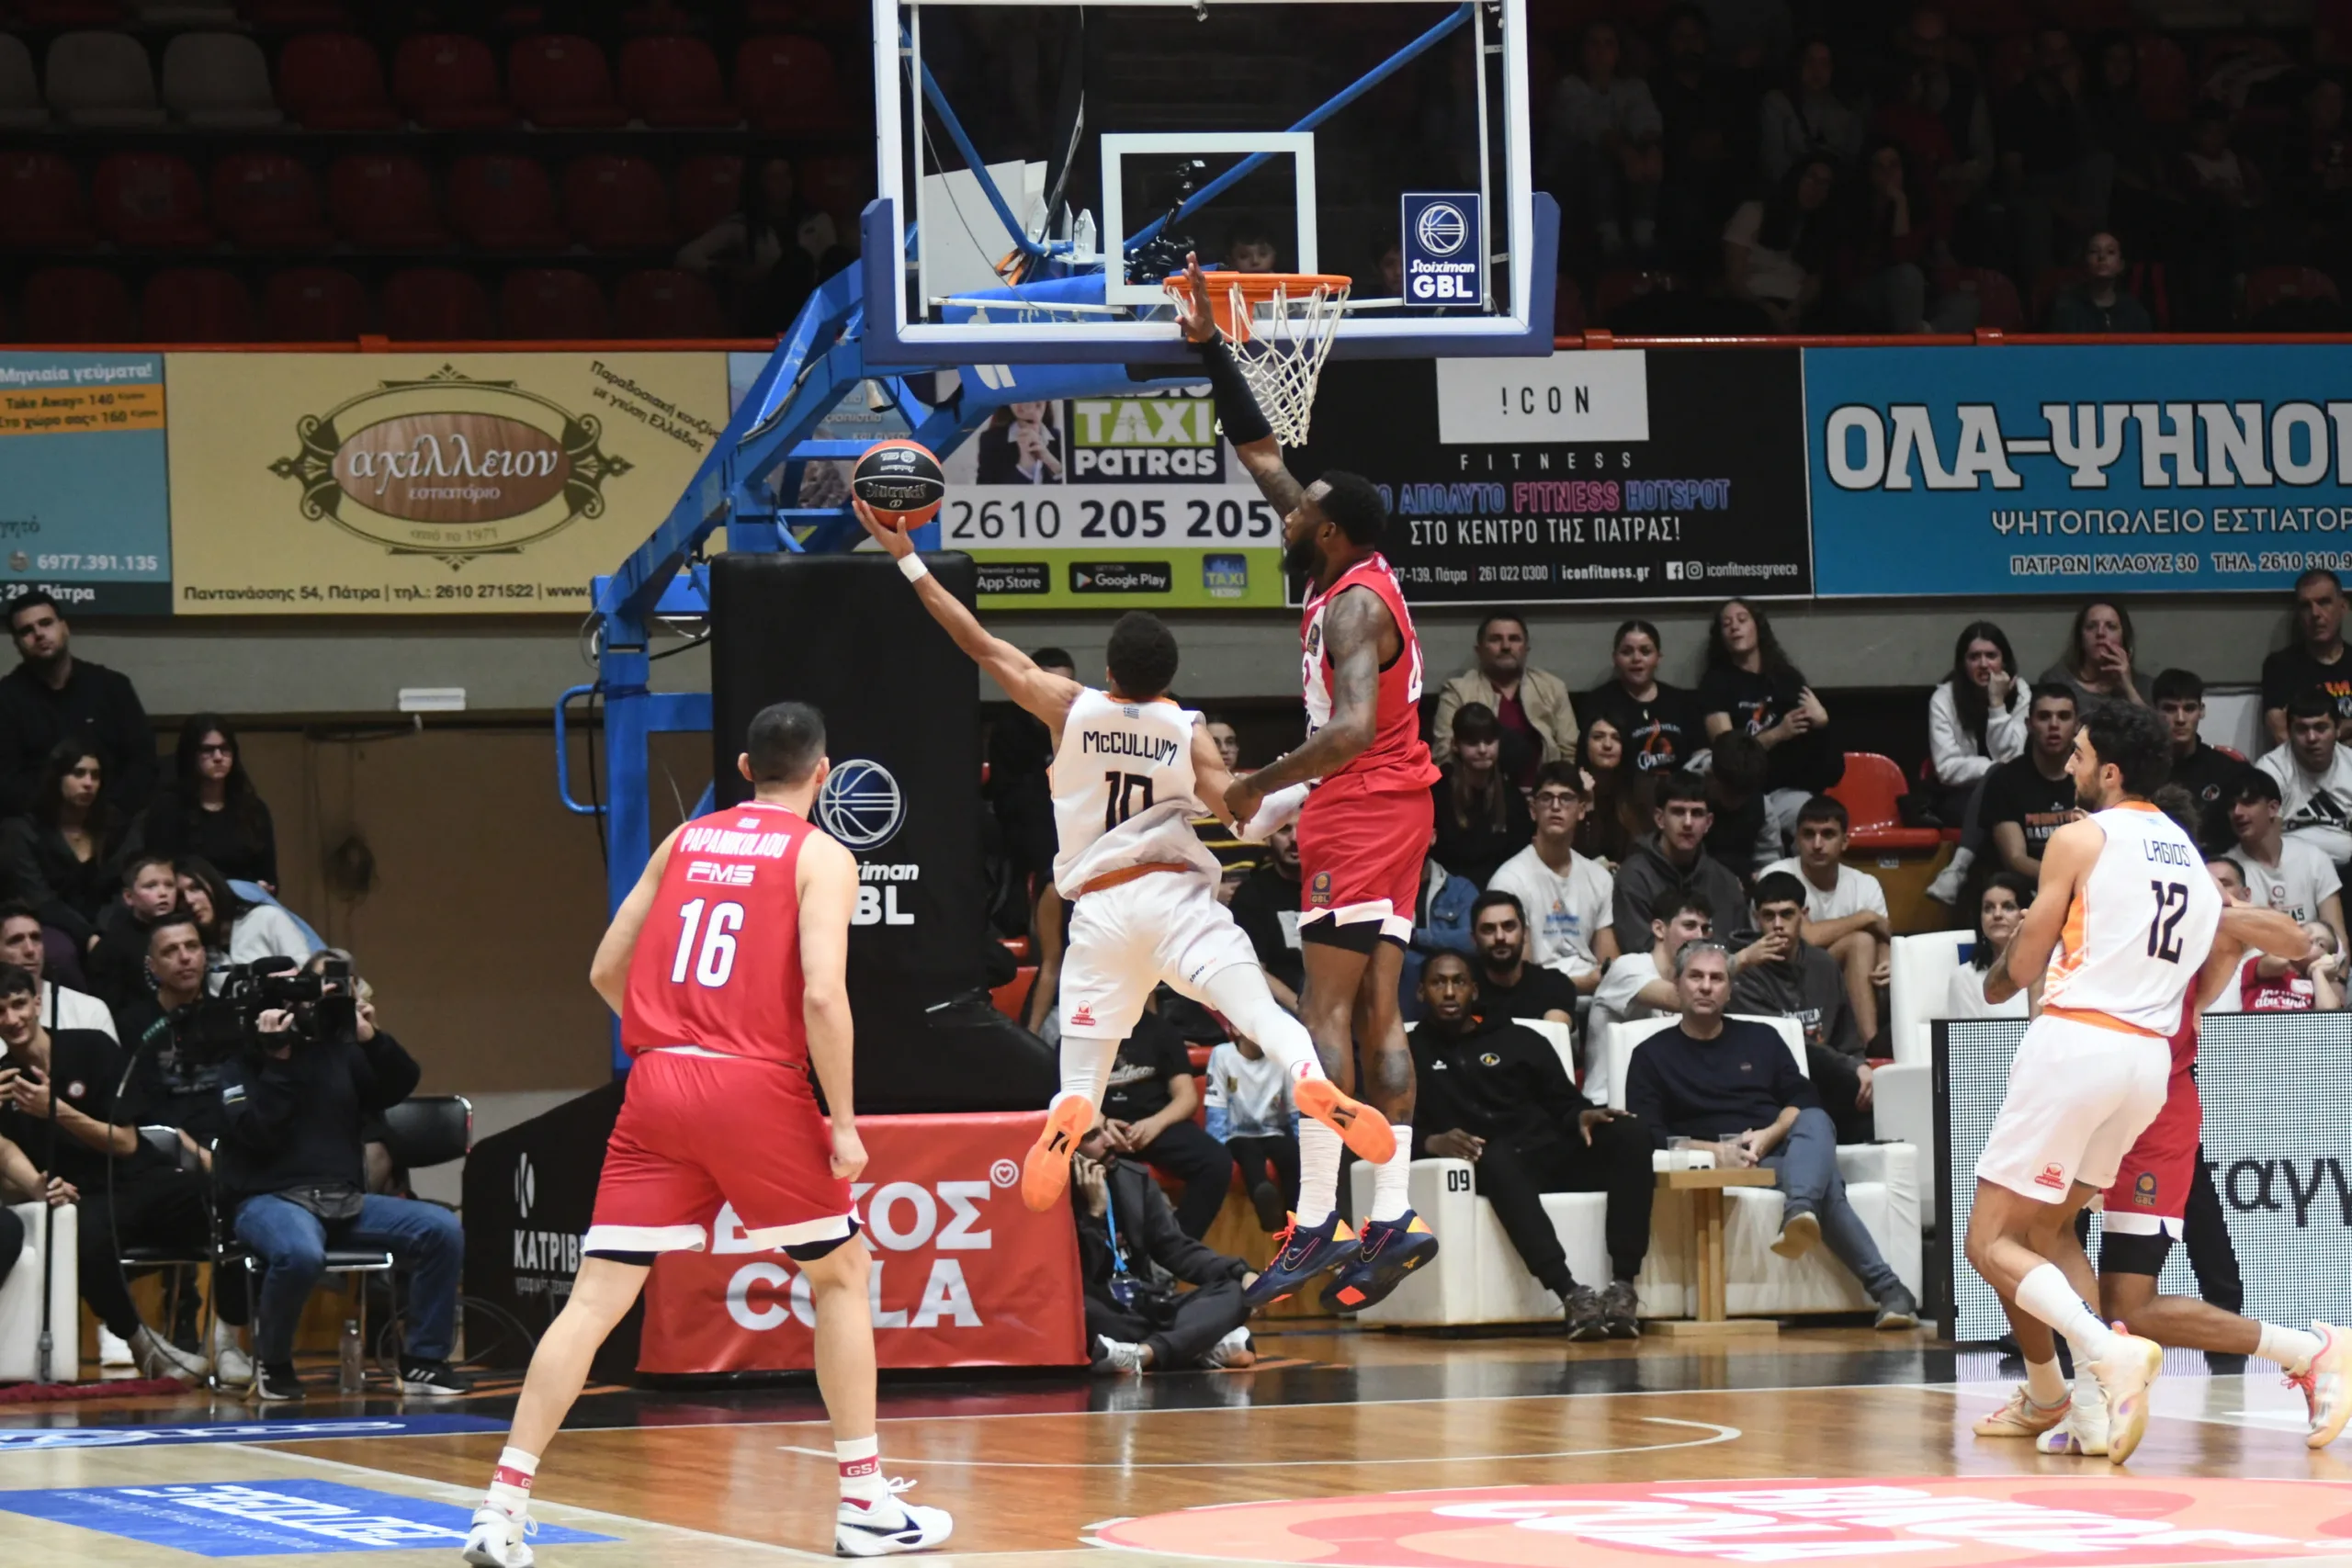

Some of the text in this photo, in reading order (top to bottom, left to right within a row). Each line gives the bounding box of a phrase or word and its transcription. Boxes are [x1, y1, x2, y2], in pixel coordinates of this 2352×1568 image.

[1410, 259, 1476, 273] Stoiximan
[1413, 275, 1474, 299] GBL
[74, 363, 153, 383] γεύματα!
[590, 359, 677, 418] Παραδοσιακή
[1501, 386, 1590, 415] !CON
[610, 393, 649, 423] γεύση
[649, 412, 705, 453] Ελλάδας
[1076, 401, 1211, 444] TAXI
[348, 434, 559, 495] αχίλλειον
[1460, 452, 1633, 470] FITNESS
[408, 486, 501, 504] εστιατόριο
[1399, 483, 1505, 514] ΑΠΟΛΥΤΟ
[1512, 480, 1620, 513] FITNESS
[1625, 479, 1730, 512] HOTSPOT
[951, 498, 1273, 539] 2610 205 205
[1410, 515, 1681, 546] ΣΤΟ ΚΕΝΤΡΟ ΤΗΣ ΠΑΤΡΑΣ!
[1991, 508, 2205, 536] ΨΗΤΟΠΩΛΕΙΟ
[465, 526, 499, 541] 1971
[37, 553, 159, 571] 6977.391.135
[1478, 565, 1548, 581] 261 022 0300
[1562, 563, 1650, 581] iconfitness.gr
[1706, 561, 1798, 580] iconfitnessgreece
[2009, 555, 2090, 576] ΠΑΤΡΩΝ
[2094, 553, 2174, 575] ΚΛΑΟΥΣ
[2175, 552, 2199, 573] 30
[2211, 551, 2256, 573] ΤΗΛ.
[2258, 551, 2301, 572] 2610
[977, 575, 1041, 592] App Store
[1094, 573, 1166, 589] Google Play
[1205, 571, 1245, 586] TAXI
[1435, 566, 1468, 585] Πάτρα
[184, 582, 380, 604] Παντανάσσης 54, Πάτρα
[435, 583, 474, 599] 2610
[478, 583, 534, 600] 271522
[1082, 730, 1178, 767] McCULLUM
[1105, 771, 1154, 832] 10
[680, 827, 791, 859] PAPANIKOLAOU
[2143, 838, 2191, 868] LAGIOS
[686, 861, 756, 884] FMS
[851, 885, 915, 926] BL
[2146, 879, 2188, 964] 12
[671, 897, 745, 988] 16
[1447, 1168, 1470, 1192] 09
[514, 1229, 585, 1273] ΚΑΤΡΙΒ
